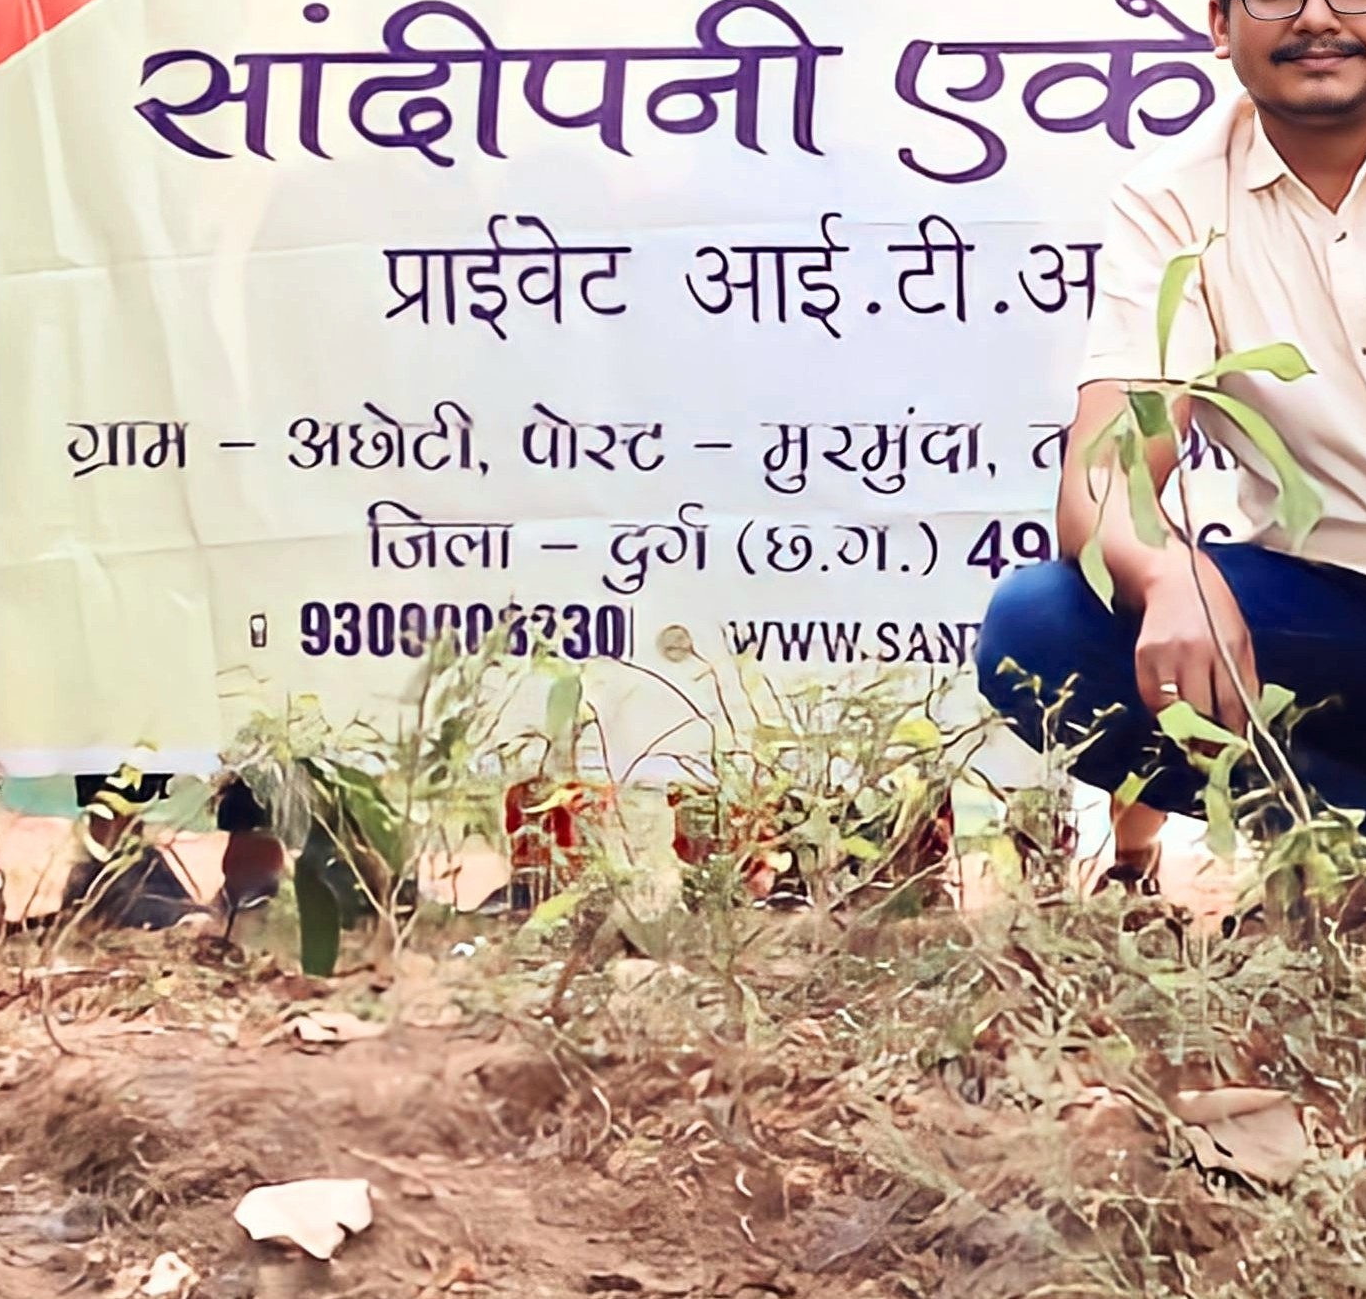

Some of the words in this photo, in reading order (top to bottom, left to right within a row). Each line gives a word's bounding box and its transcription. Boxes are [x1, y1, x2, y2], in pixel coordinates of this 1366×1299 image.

[382, 214, 633, 340] प्राईवेट
[685, 212, 1103, 339] आई.टी.अ
[67, 420, 189, 478] ग्राम
[288, 400, 489, 477] अछोटी,
[521, 402, 666, 473] पोस्ट
[366, 500, 514, 570] जिला
[601, 502, 709, 595] दुर्ग
[735, 520, 939, 576] (छ.ग.)
